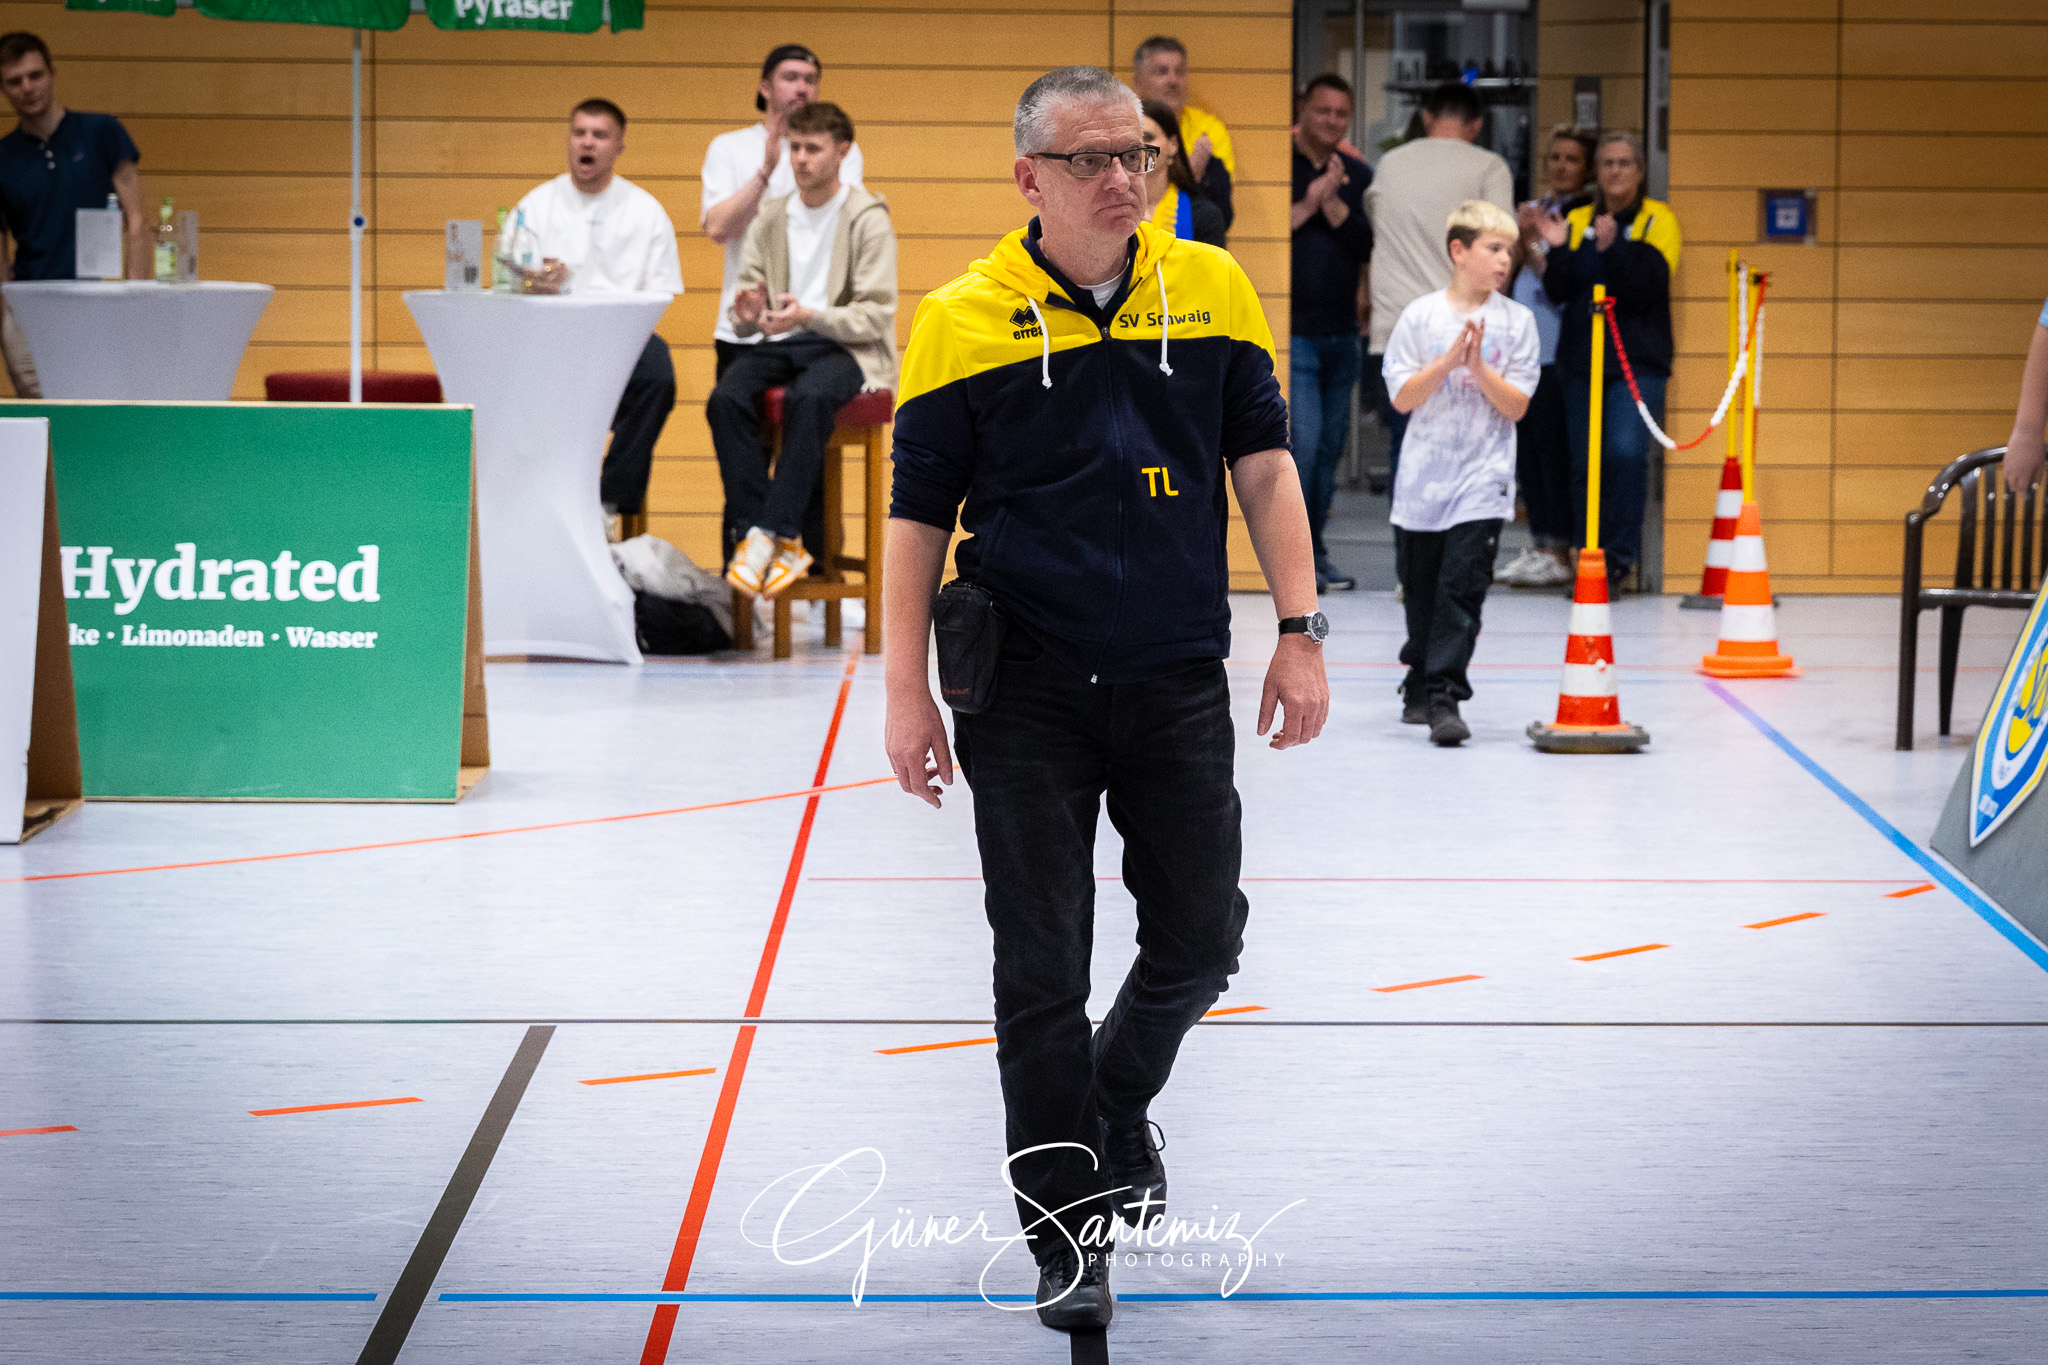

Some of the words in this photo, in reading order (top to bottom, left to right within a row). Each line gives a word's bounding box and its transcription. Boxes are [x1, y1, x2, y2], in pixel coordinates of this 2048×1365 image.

[1118, 313, 1139, 328] SV
[1141, 467, 1179, 497] TL
[60, 543, 381, 615] Hydrated
[121, 624, 265, 647] Limonaden
[286, 627, 378, 649] Wasser
